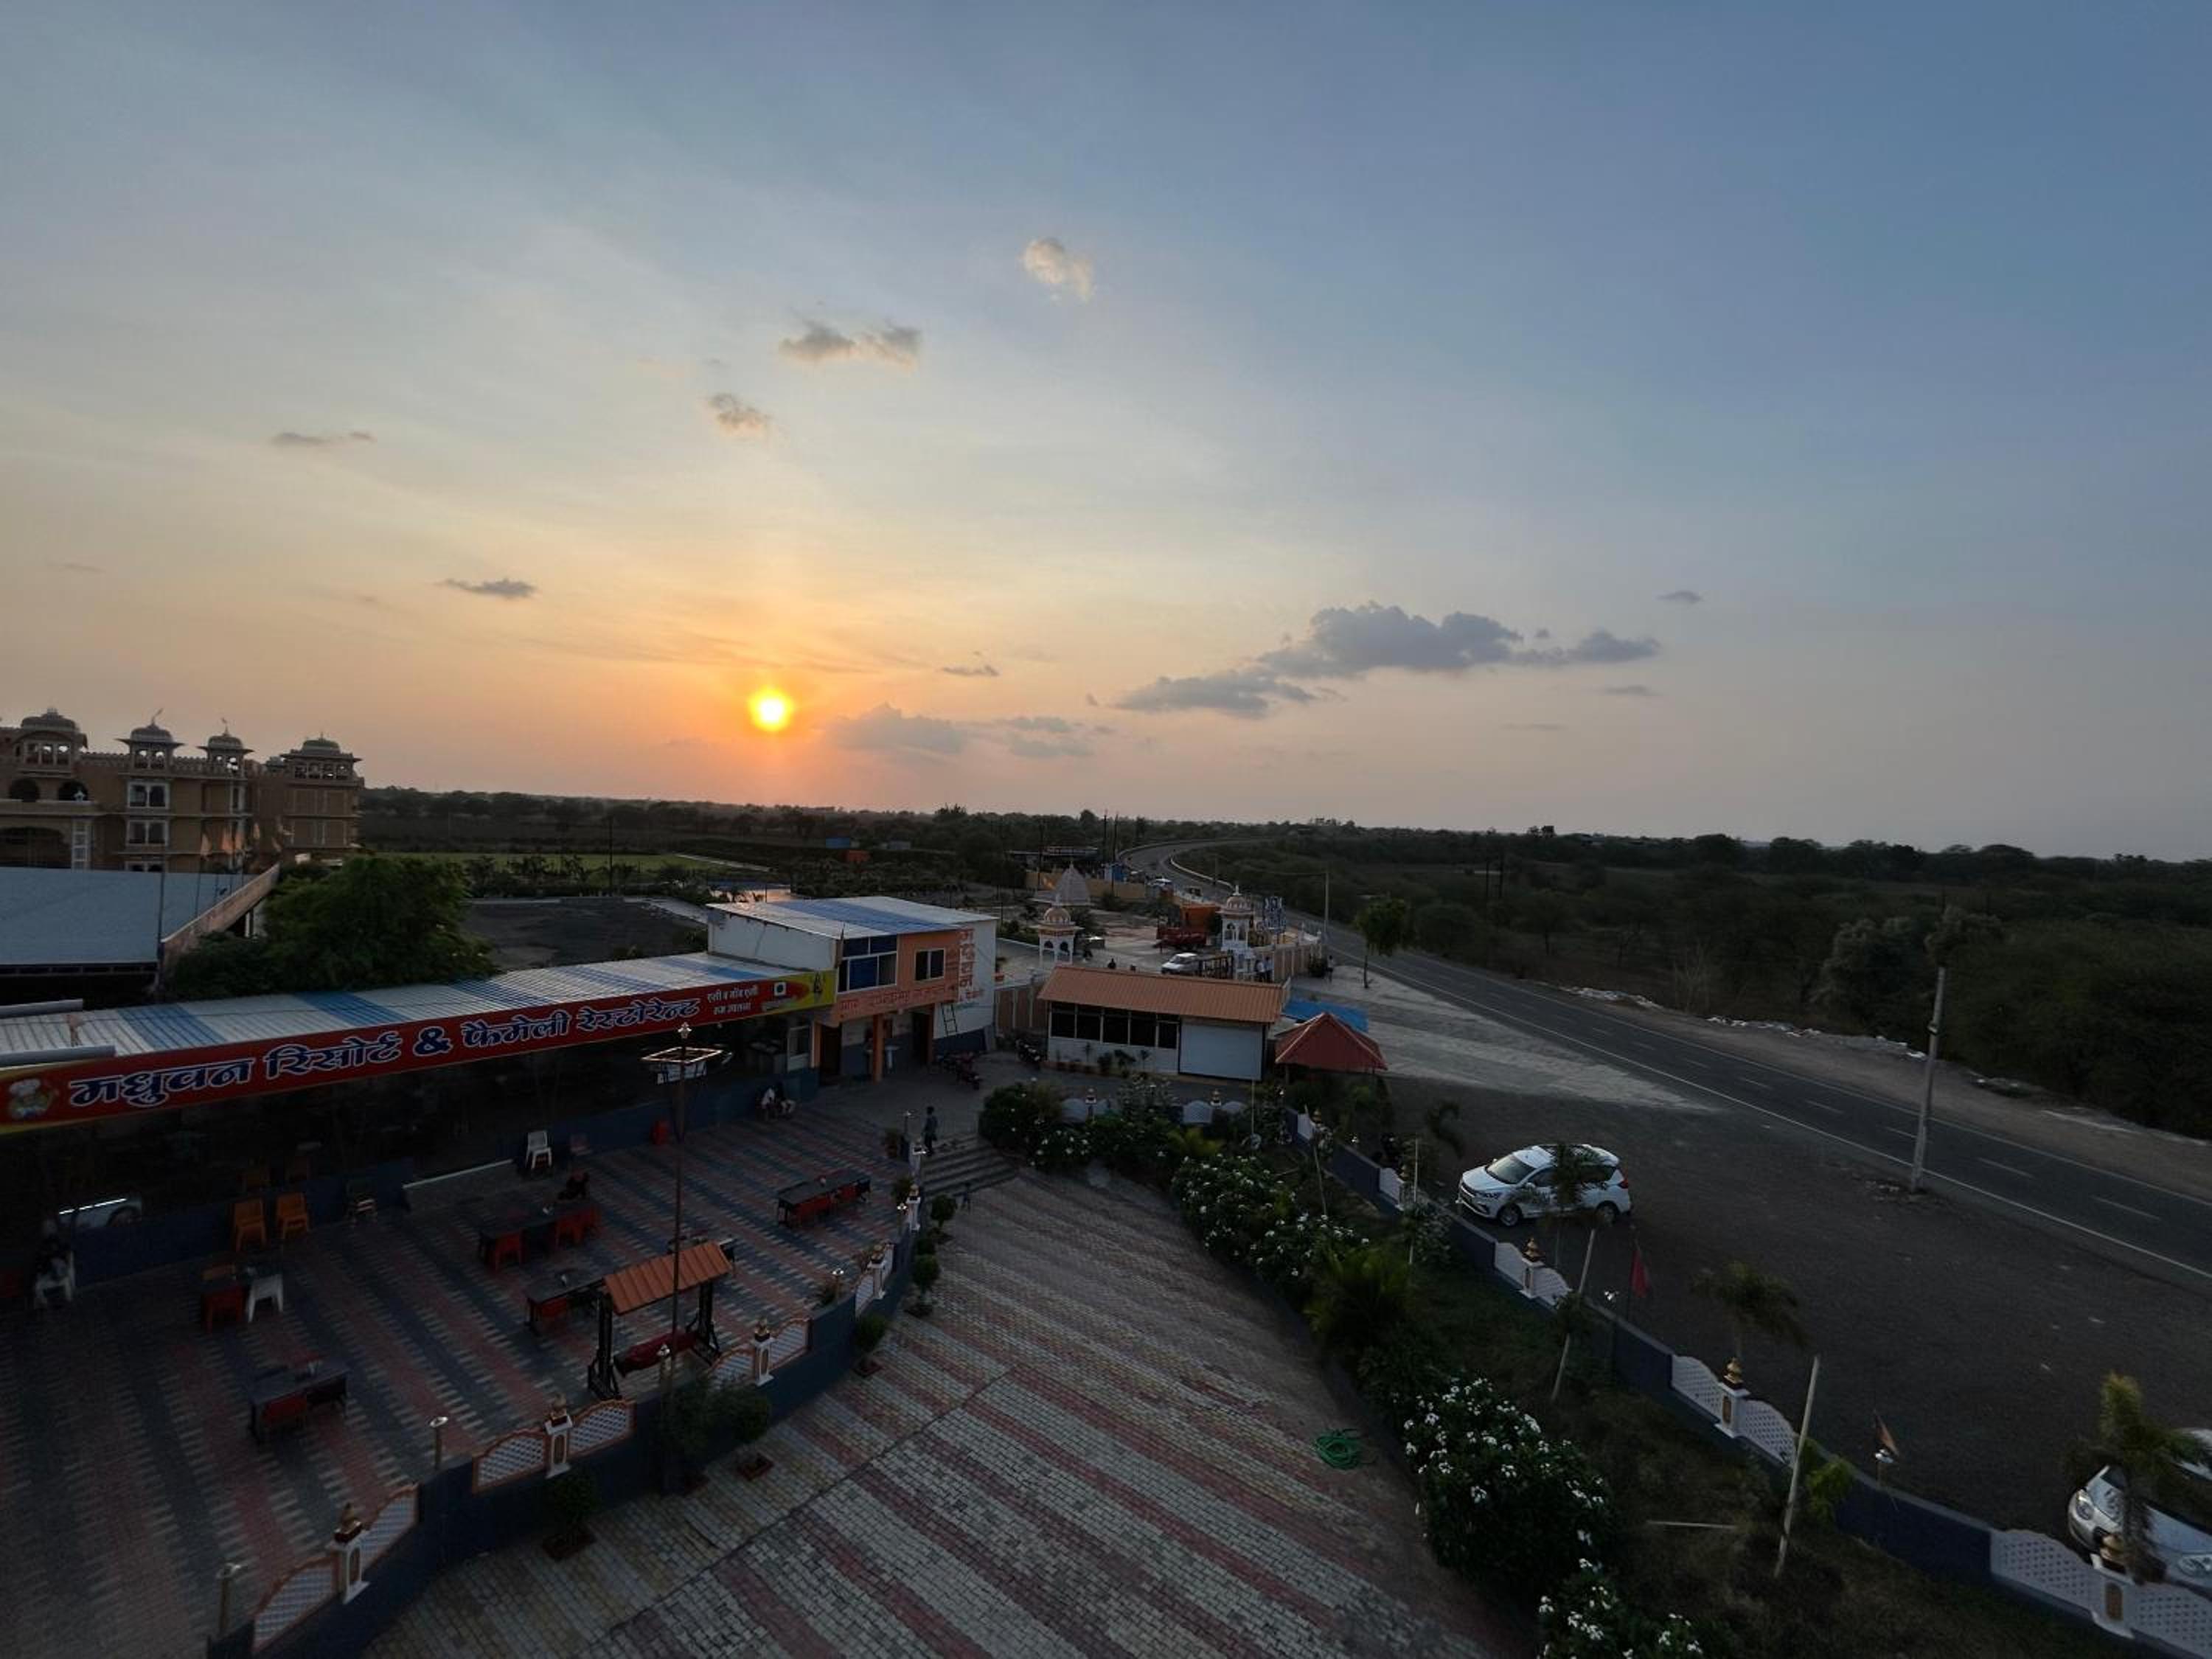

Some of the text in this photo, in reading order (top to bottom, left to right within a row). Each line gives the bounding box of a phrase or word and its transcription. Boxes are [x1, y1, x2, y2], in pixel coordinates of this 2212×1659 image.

[69, 1057, 255, 1108] मधुवन
[263, 1031, 403, 1080] रिसोर्ट
[413, 1026, 453, 1057] &
